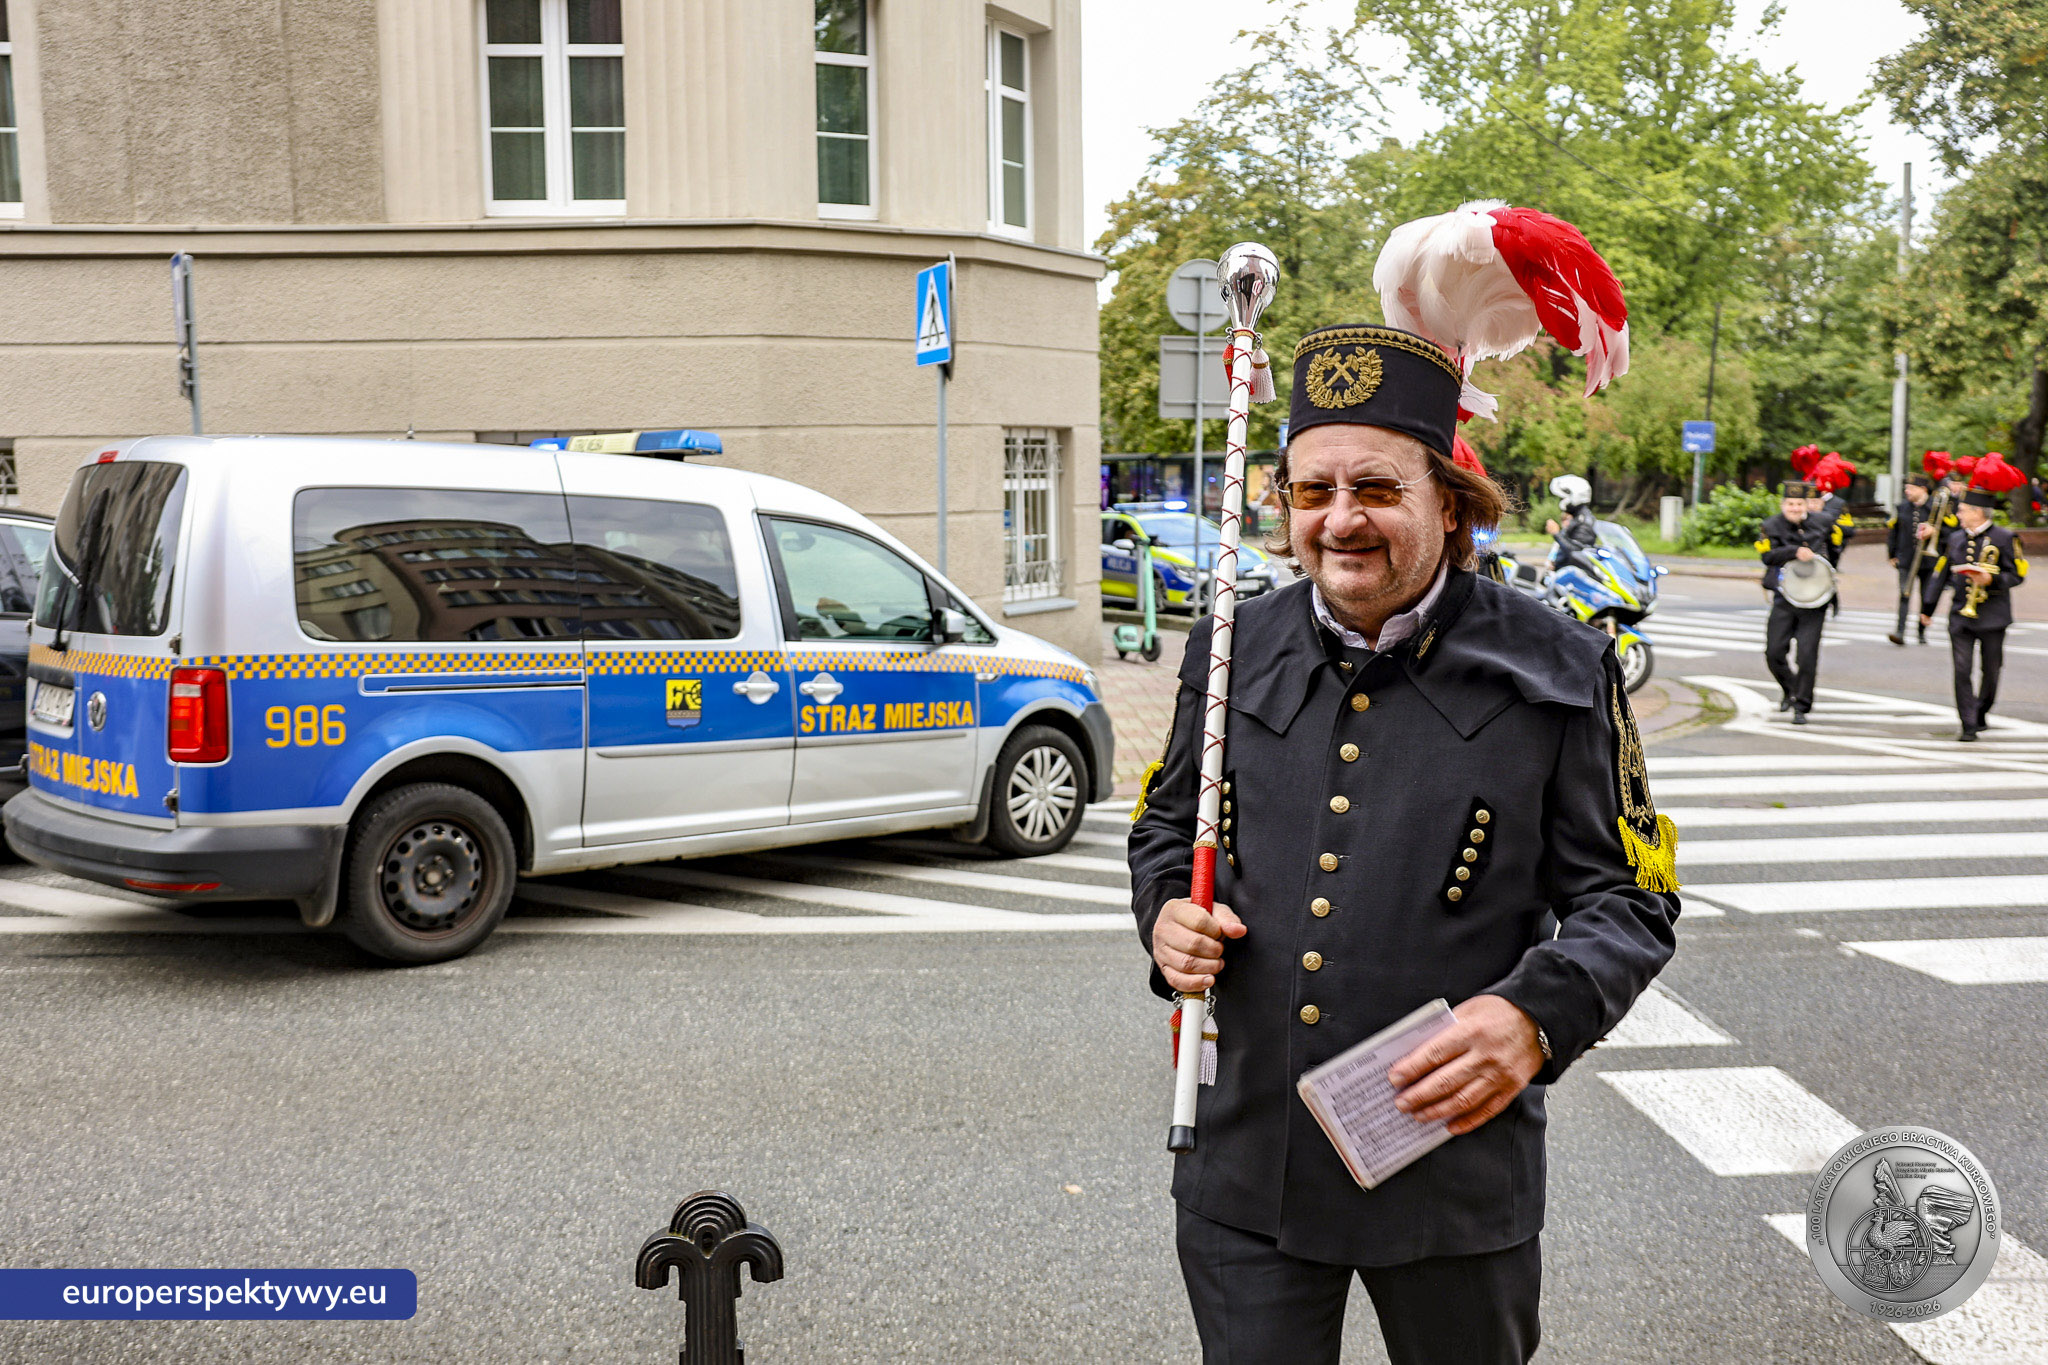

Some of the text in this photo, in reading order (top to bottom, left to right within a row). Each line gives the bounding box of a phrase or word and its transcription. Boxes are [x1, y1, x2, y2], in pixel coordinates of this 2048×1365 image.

[265, 704, 346, 748] 986
[884, 700, 975, 729] MIEJSKA
[62, 752, 140, 799] MIEJSKA
